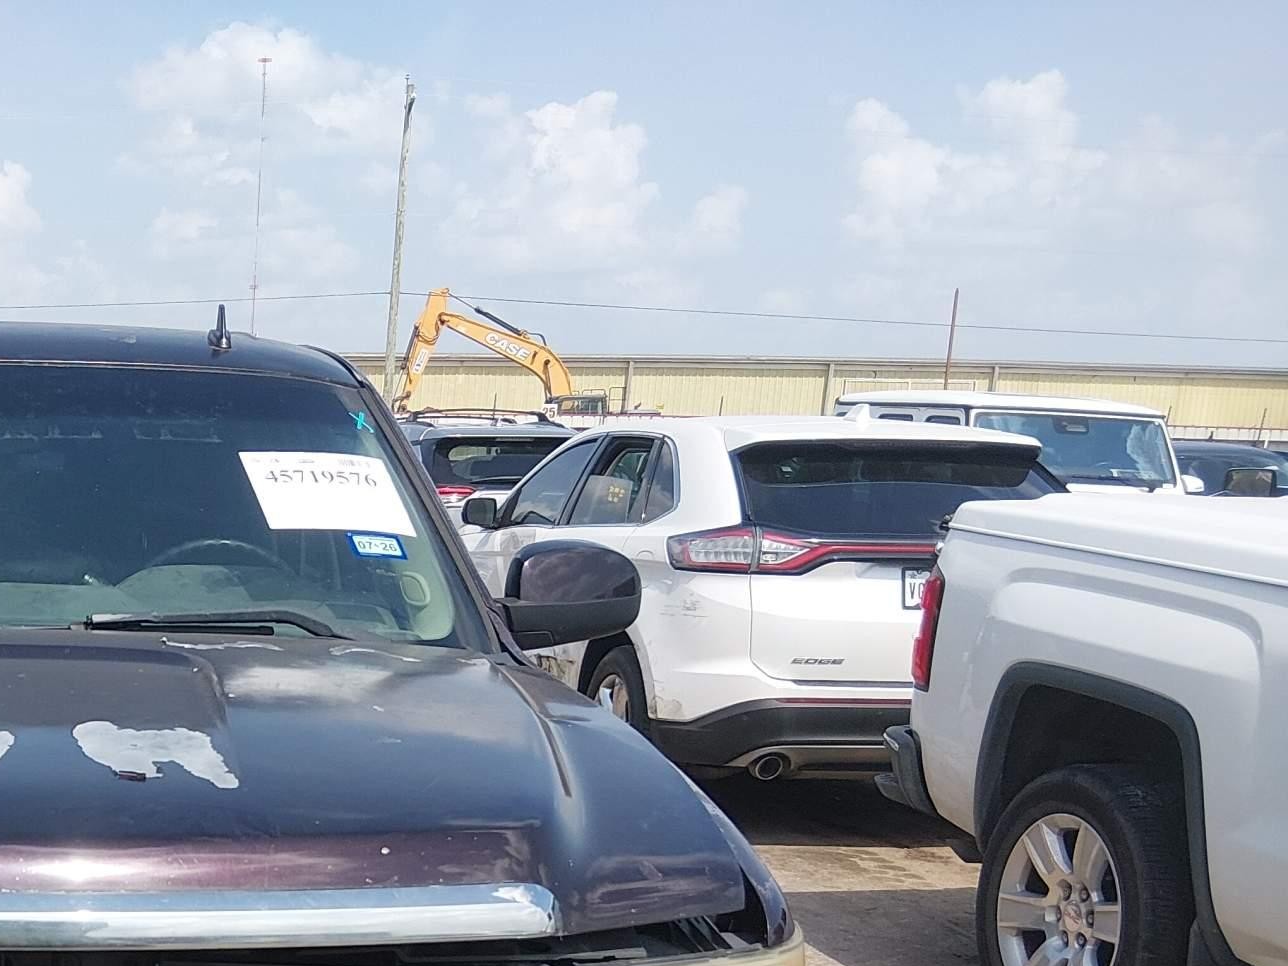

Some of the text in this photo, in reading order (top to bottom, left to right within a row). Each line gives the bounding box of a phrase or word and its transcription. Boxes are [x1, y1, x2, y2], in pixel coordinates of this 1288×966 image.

[485, 333, 531, 361] CASE
[264, 470, 377, 488] 45719576
[791, 657, 845, 665] EDGE
